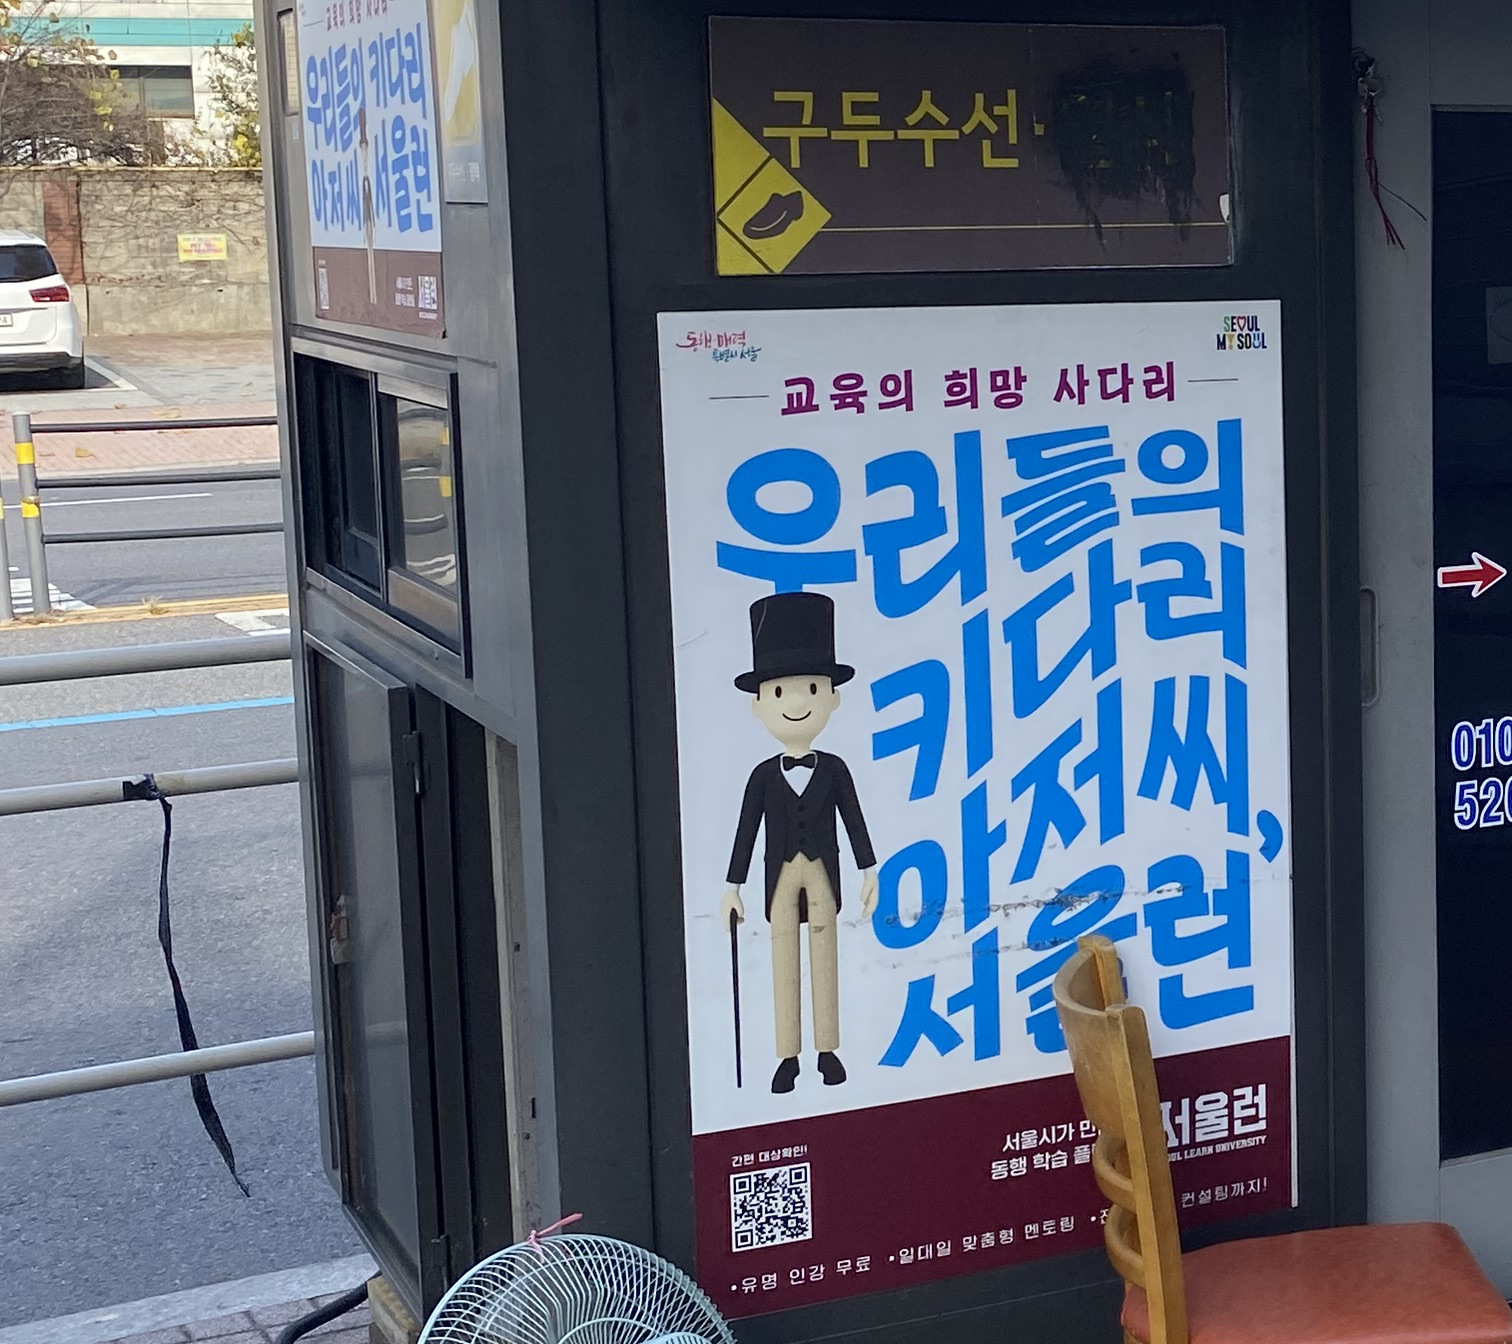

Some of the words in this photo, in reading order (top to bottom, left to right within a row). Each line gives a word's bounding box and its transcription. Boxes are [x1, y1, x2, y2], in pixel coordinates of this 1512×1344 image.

[306, 37, 367, 154] 우리들의
[369, 22, 428, 121] 키다리
[762, 88, 1020, 169] 구두수선
[373, 114, 434, 234] 서울런
[1237, 332, 1268, 351] SOUL
[780, 368, 914, 416] 교육의
[943, 365, 1028, 411] 희망
[1053, 360, 1177, 406] 사다리
[715, 417, 1246, 619] 우리들의
[870, 537, 1247, 802] 키다리
[872, 672, 1284, 950] 아저씨,
[877, 848, 1255, 1068] 서울런
[1002, 1122, 1075, 1152] 서울시가
[1160, 1083, 1267, 1148] 서울런
[731, 1153, 755, 1168] 간편
[758, 1143, 808, 1163] 대상확인!
[990, 1155, 1028, 1181] 동행
[1032, 1149, 1069, 1171] 학습
[1184, 1145, 1214, 1159] LEARN
[1215, 1134, 1268, 1154] UNIVERSITY
[1181, 1176, 1268, 1209] 컨설팅까지!
[899, 1239, 952, 1265] 일대일
[962, 1227, 1014, 1253] 맞춤형
[1024, 1215, 1075, 1240] 멘토링
[741, 1272, 778, 1294] 유명
[789, 1263, 826, 1286] 인강
[836, 1255, 871, 1275] 무료
